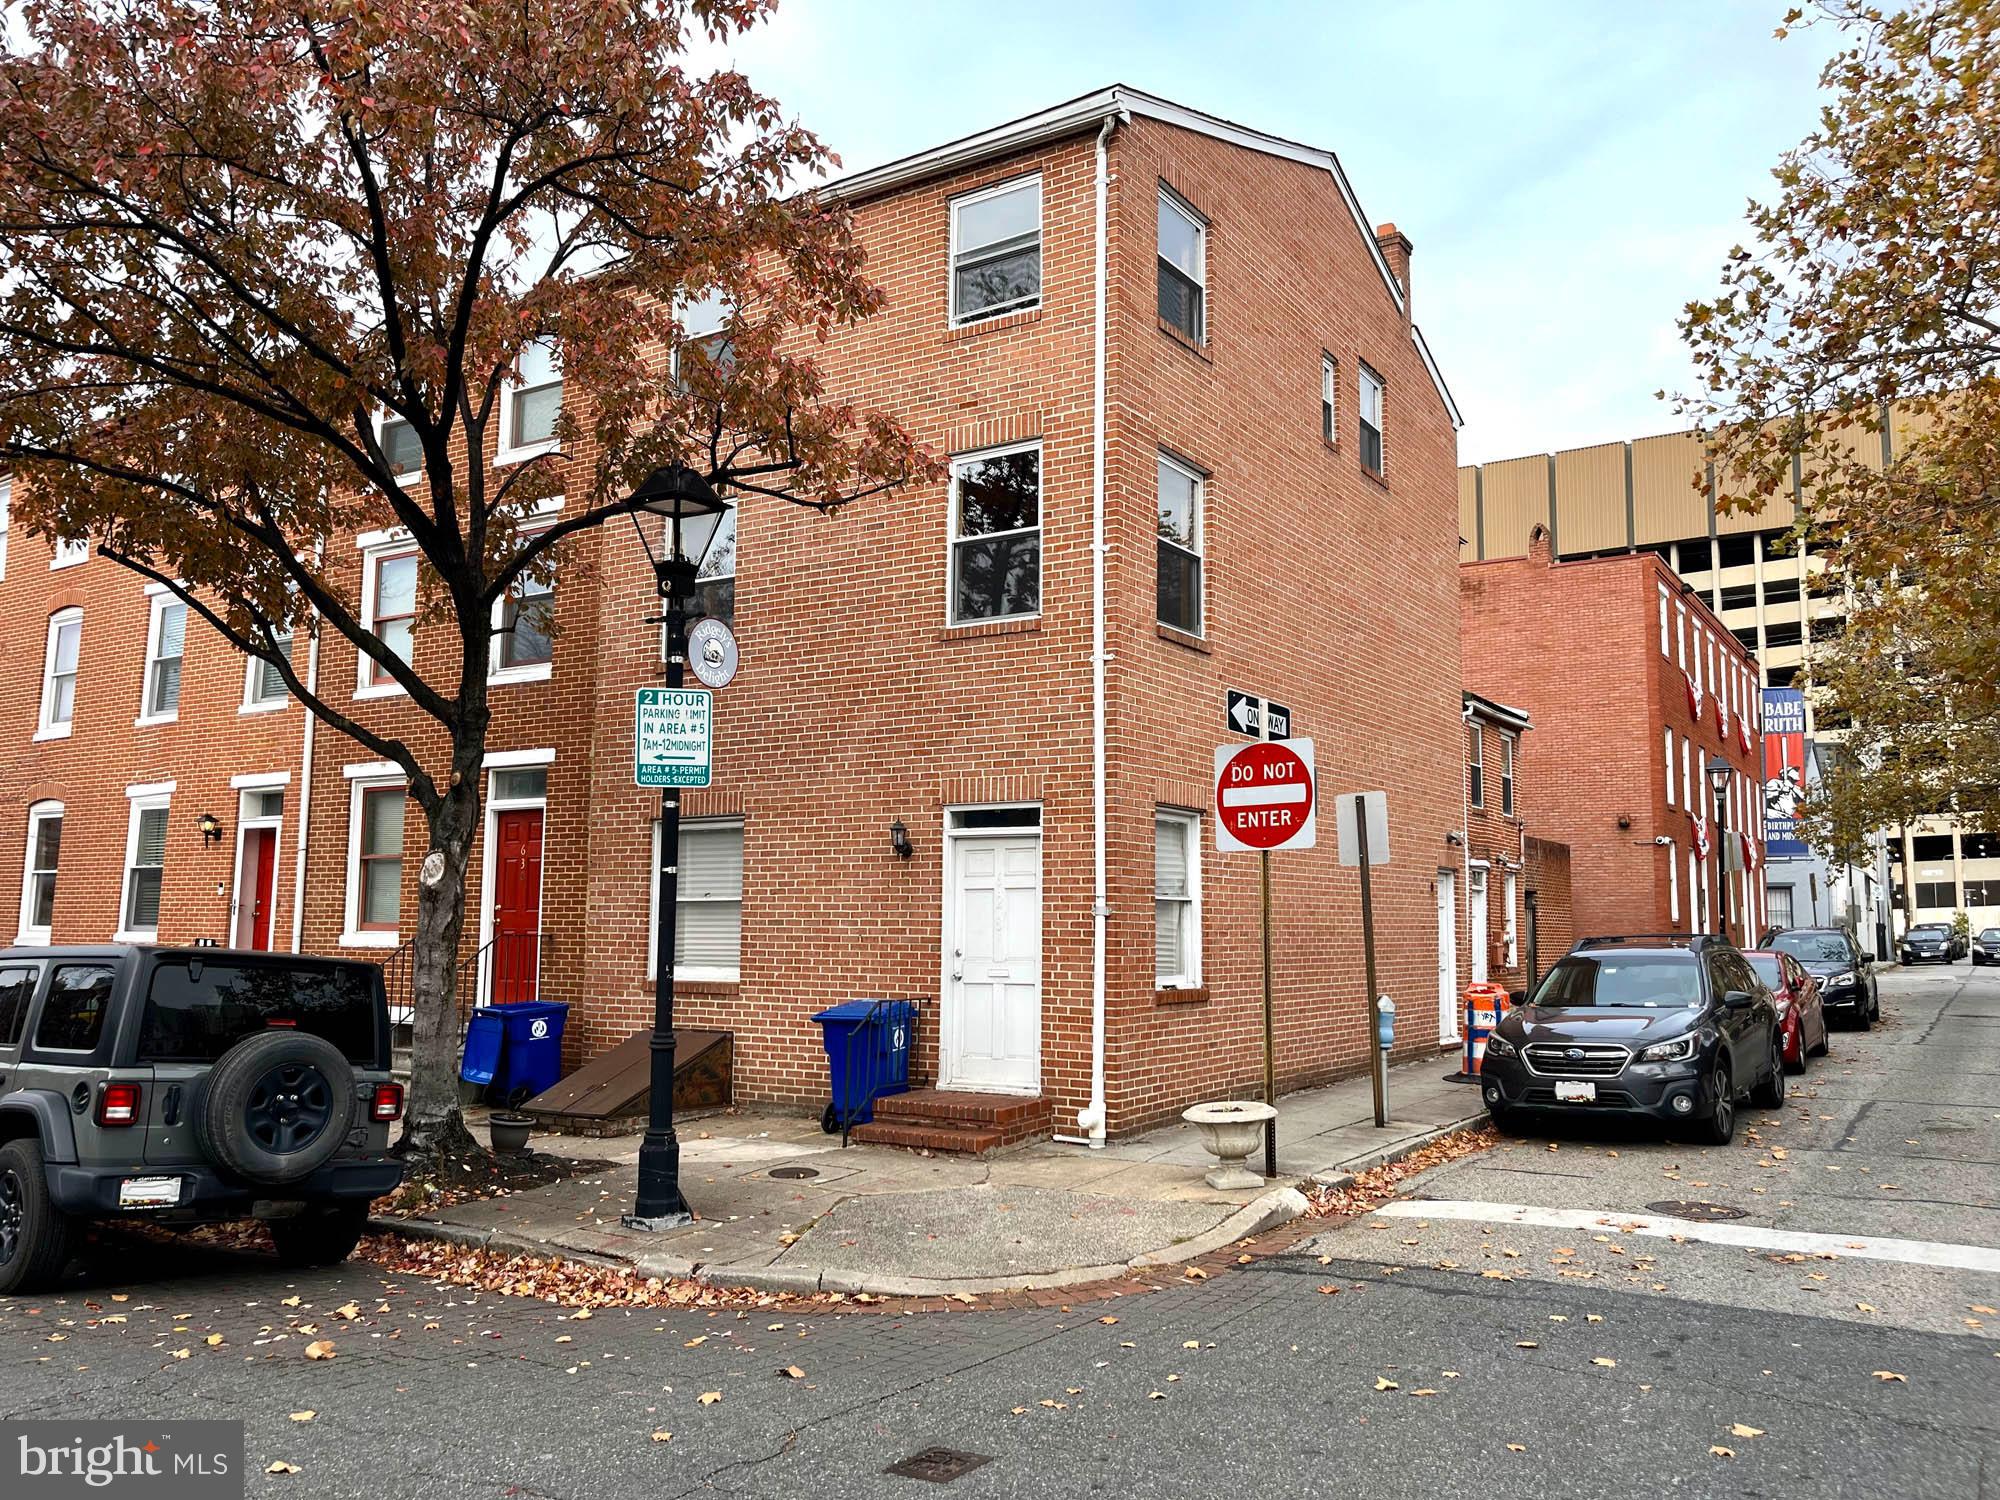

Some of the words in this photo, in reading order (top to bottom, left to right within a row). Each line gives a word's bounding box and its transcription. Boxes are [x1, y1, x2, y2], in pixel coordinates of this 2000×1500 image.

[694, 624, 734, 649] Ridgely's
[695, 662, 731, 687] Delight
[643, 691, 654, 704] 2
[662, 694, 705, 706] HOUR
[643, 708, 681, 719] PARKING
[1764, 701, 1802, 717] BABE
[1247, 708, 1260, 726] ON
[1267, 712, 1286, 733] WAY
[1764, 717, 1803, 732] RUTH
[643, 722, 654, 734] IN
[659, 722, 687, 735] AREA
[641, 765, 663, 774] AREA
[679, 767, 707, 775] PERMIT
[1231, 765, 1253, 782] DO
[1263, 761, 1296, 780] NOT
[640, 775, 671, 783] HOLDERS
[673, 775, 706, 784] EXCEPTED
[1237, 809, 1292, 828] ENTER
[1767, 831, 1781, 841] AND
